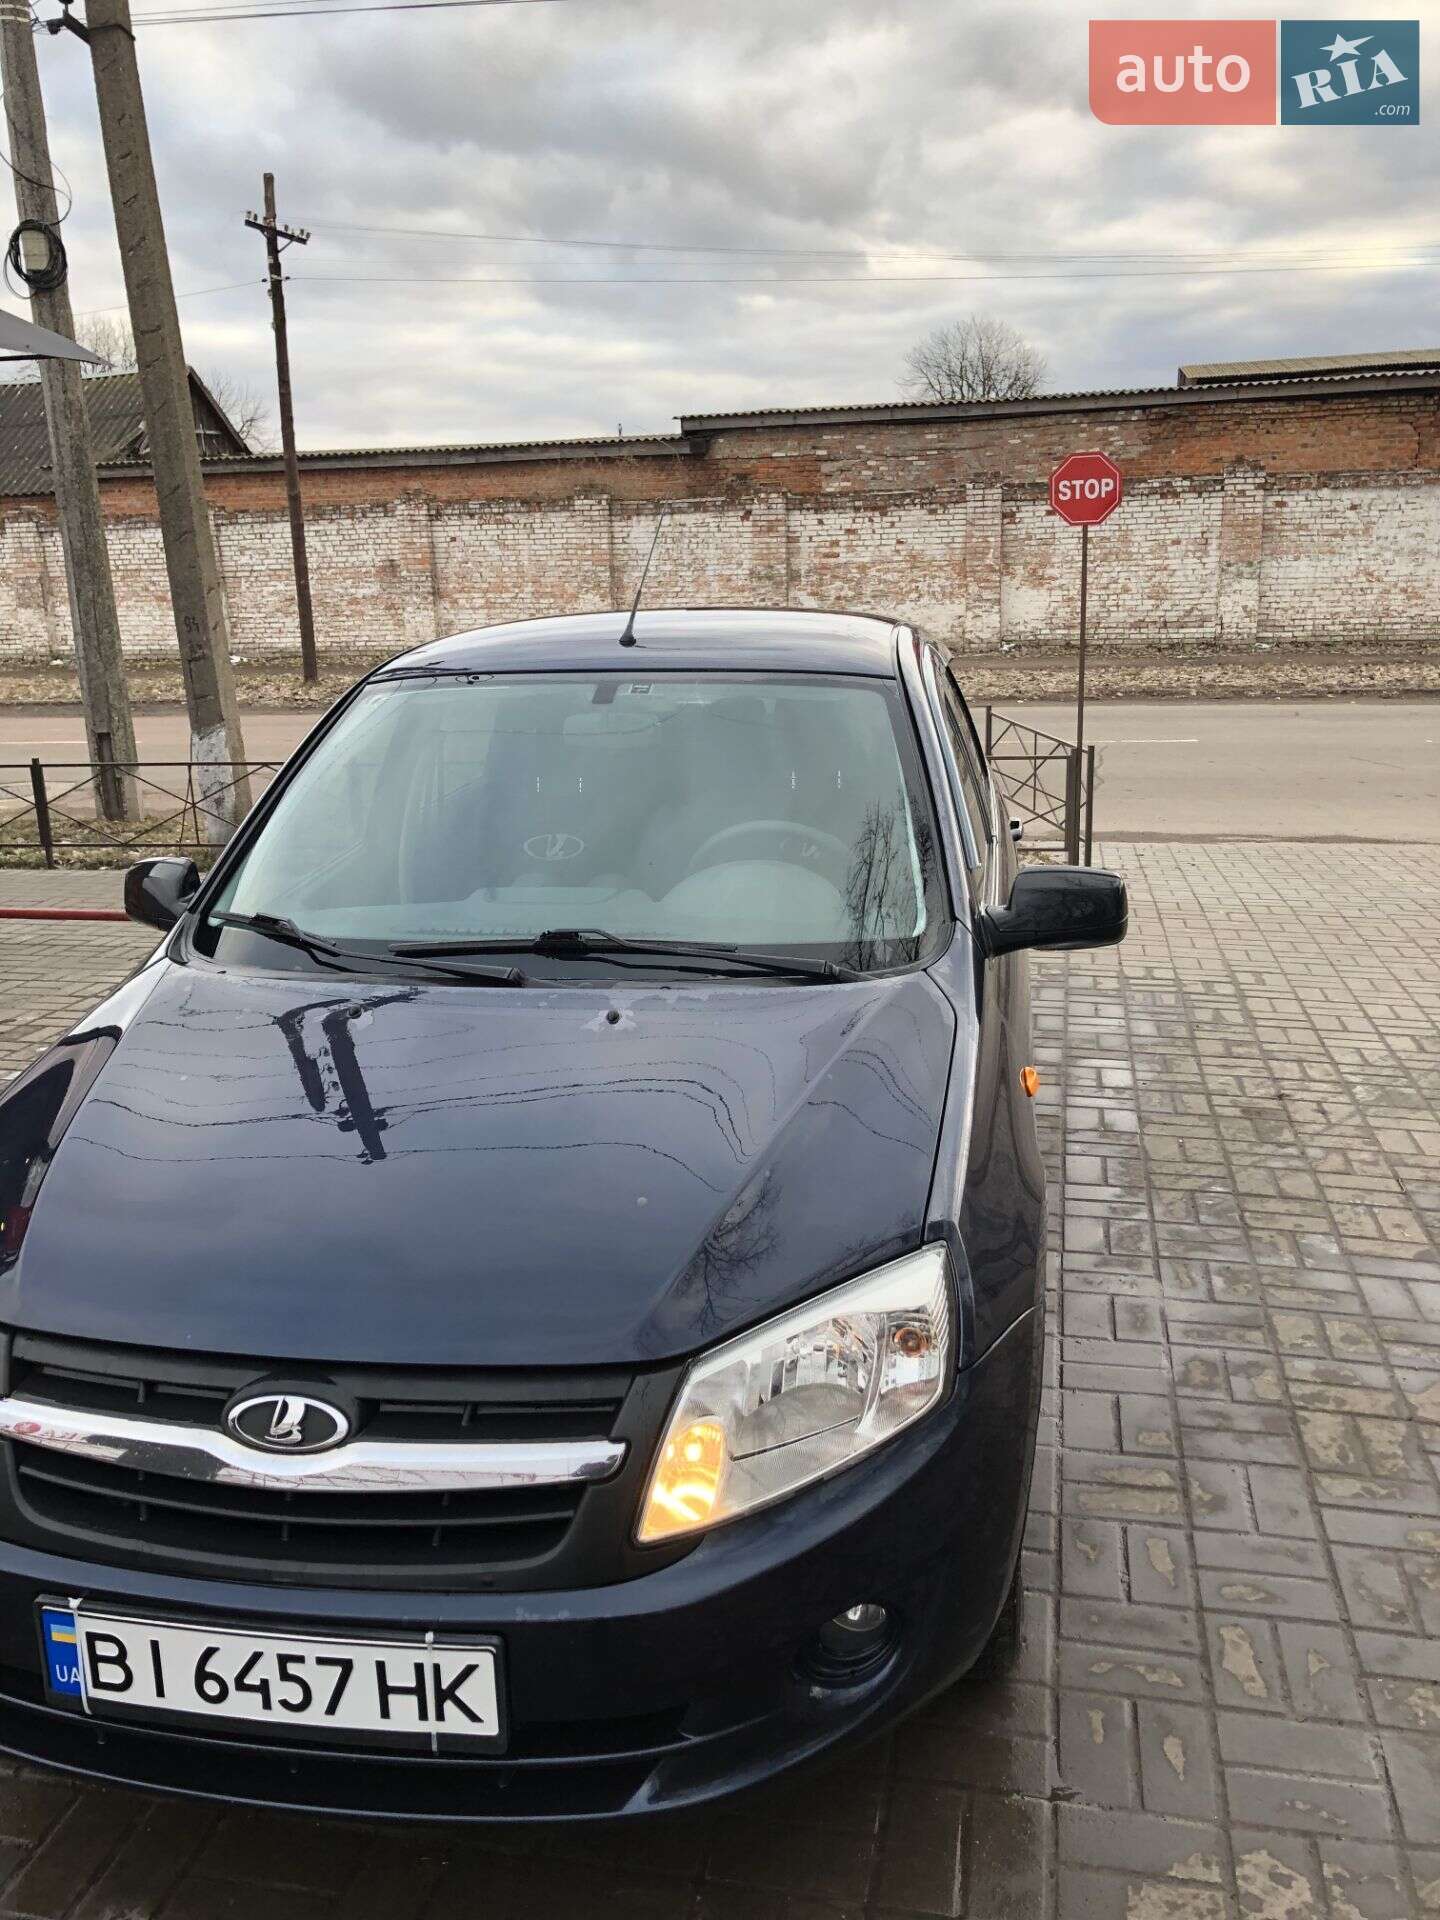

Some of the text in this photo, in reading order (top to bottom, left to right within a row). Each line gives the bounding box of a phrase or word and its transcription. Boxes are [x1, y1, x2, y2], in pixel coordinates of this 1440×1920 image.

[1058, 478, 1114, 500] STOP
[55, 1664, 81, 1684] UA
[85, 1631, 484, 1724] BI 6457 HK
